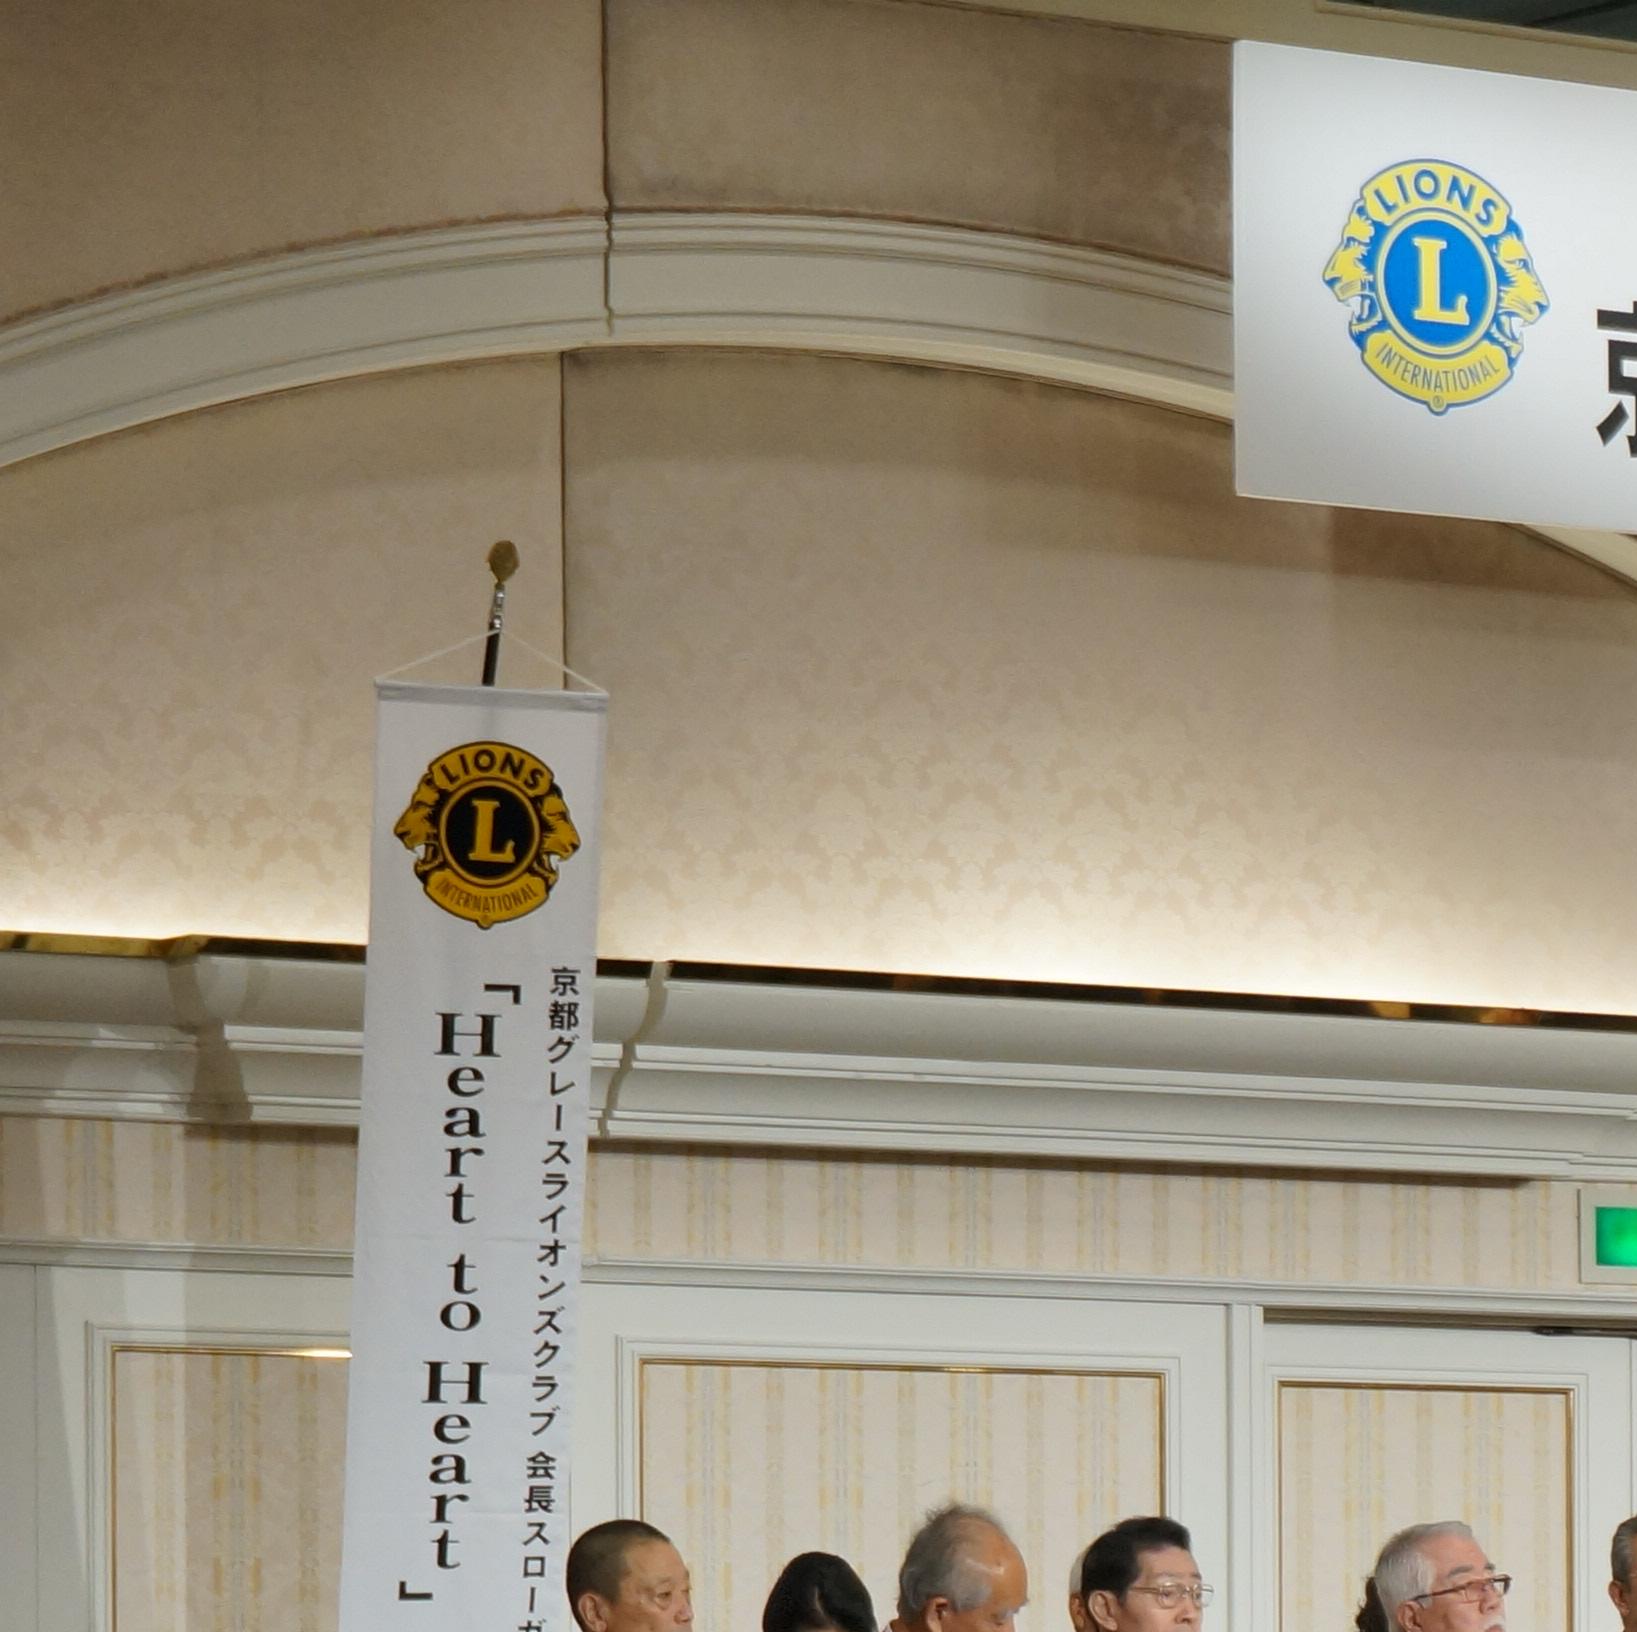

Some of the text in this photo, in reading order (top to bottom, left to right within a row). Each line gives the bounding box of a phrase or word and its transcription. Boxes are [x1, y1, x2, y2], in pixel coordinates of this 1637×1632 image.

[1375, 167, 1500, 229] LIONS
[1413, 238, 1469, 329] L
[1375, 344, 1501, 397] INTERNATIONAL
[439, 748, 545, 791] LIONS
[468, 798, 517, 864] L
[435, 876, 538, 915] INTERNATIONAL
[527, 966, 582, 1437] 京都グレースライオンズクラブ
[438, 1252, 482, 1333] to
